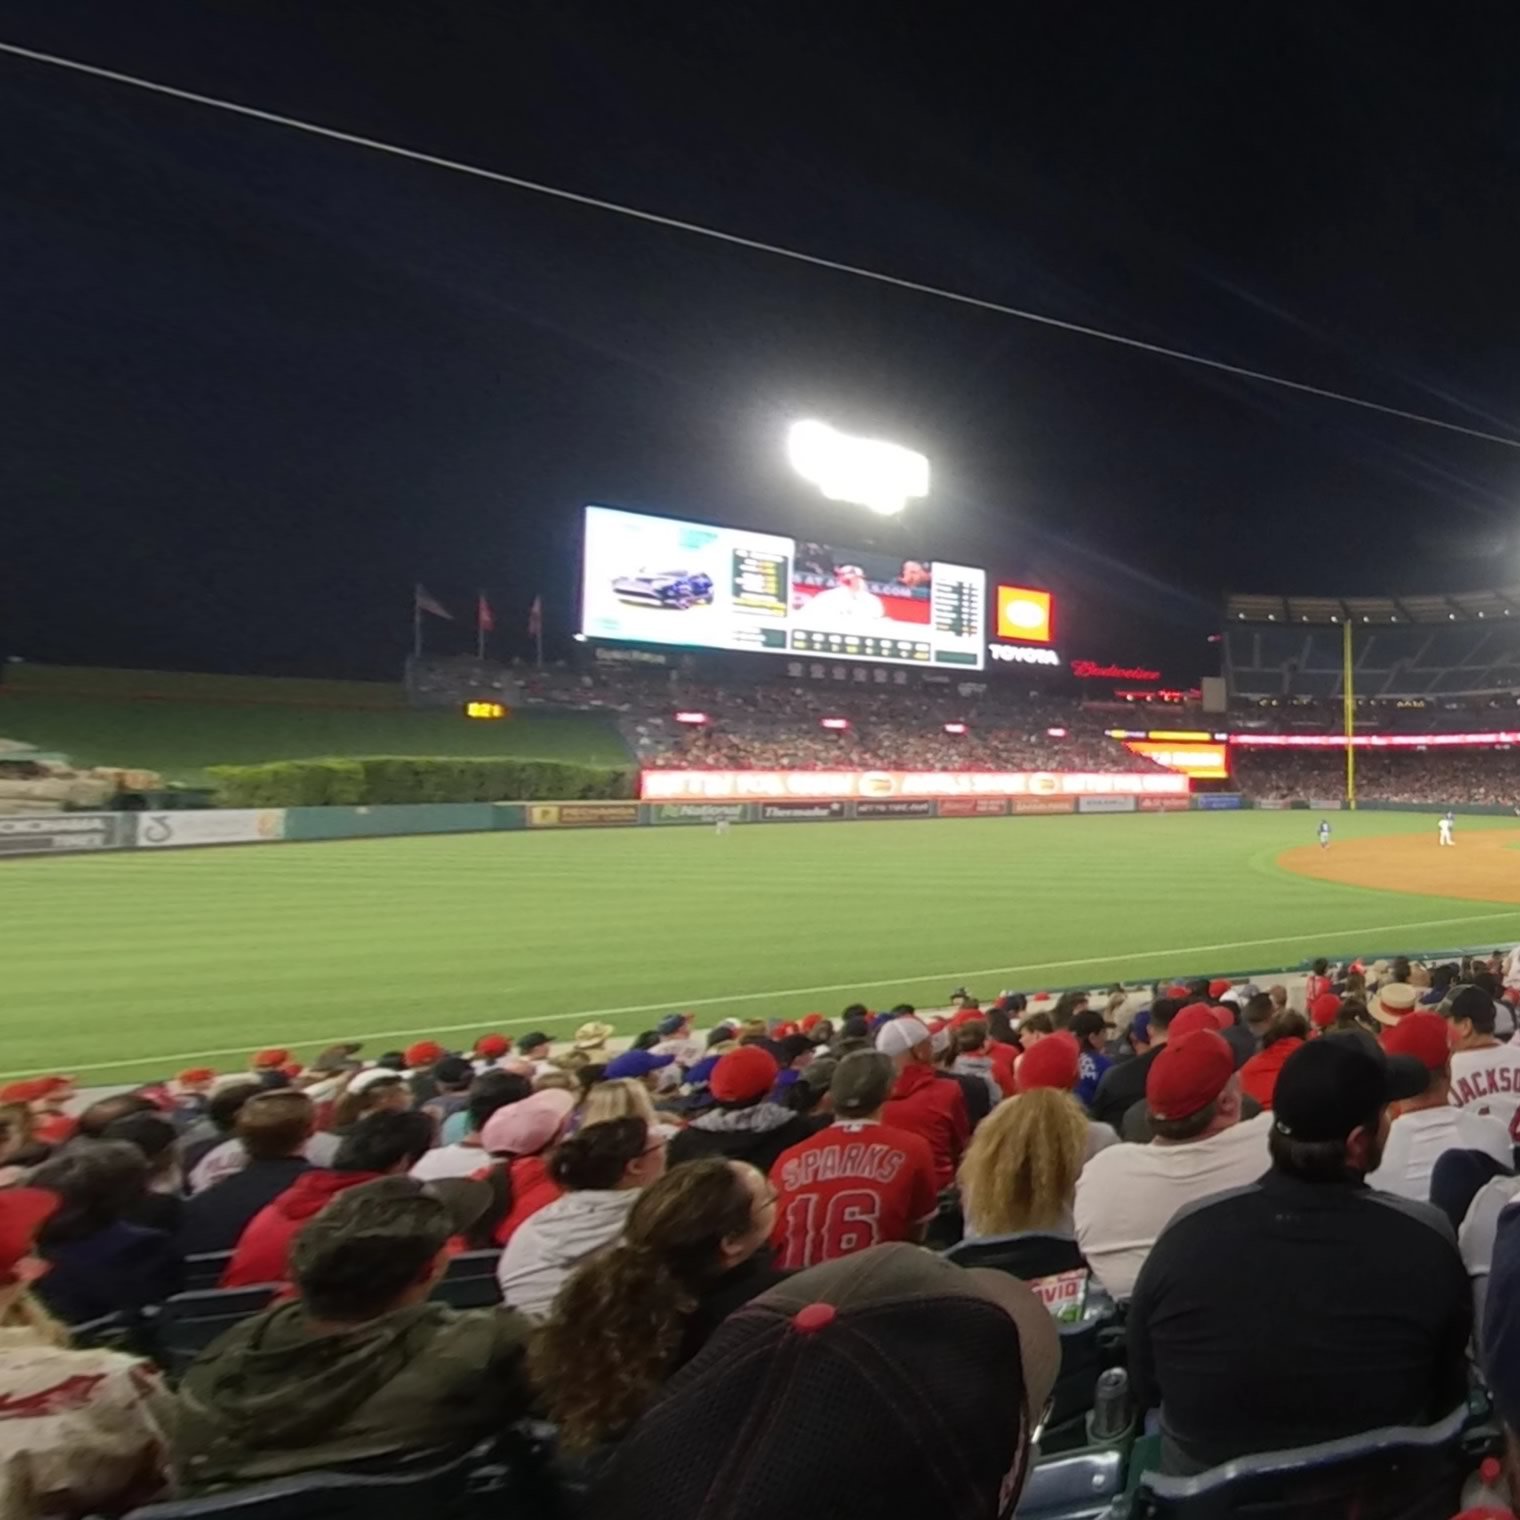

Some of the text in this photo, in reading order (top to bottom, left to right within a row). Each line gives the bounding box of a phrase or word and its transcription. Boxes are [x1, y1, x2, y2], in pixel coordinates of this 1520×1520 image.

[988, 644, 1059, 665] TOYOTA
[1071, 660, 1159, 680] Budweiser
[679, 804, 743, 817] National
[765, 806, 831, 818] Thermador
[782, 1143, 905, 1190] SPARKS
[784, 1190, 880, 1268] 16
